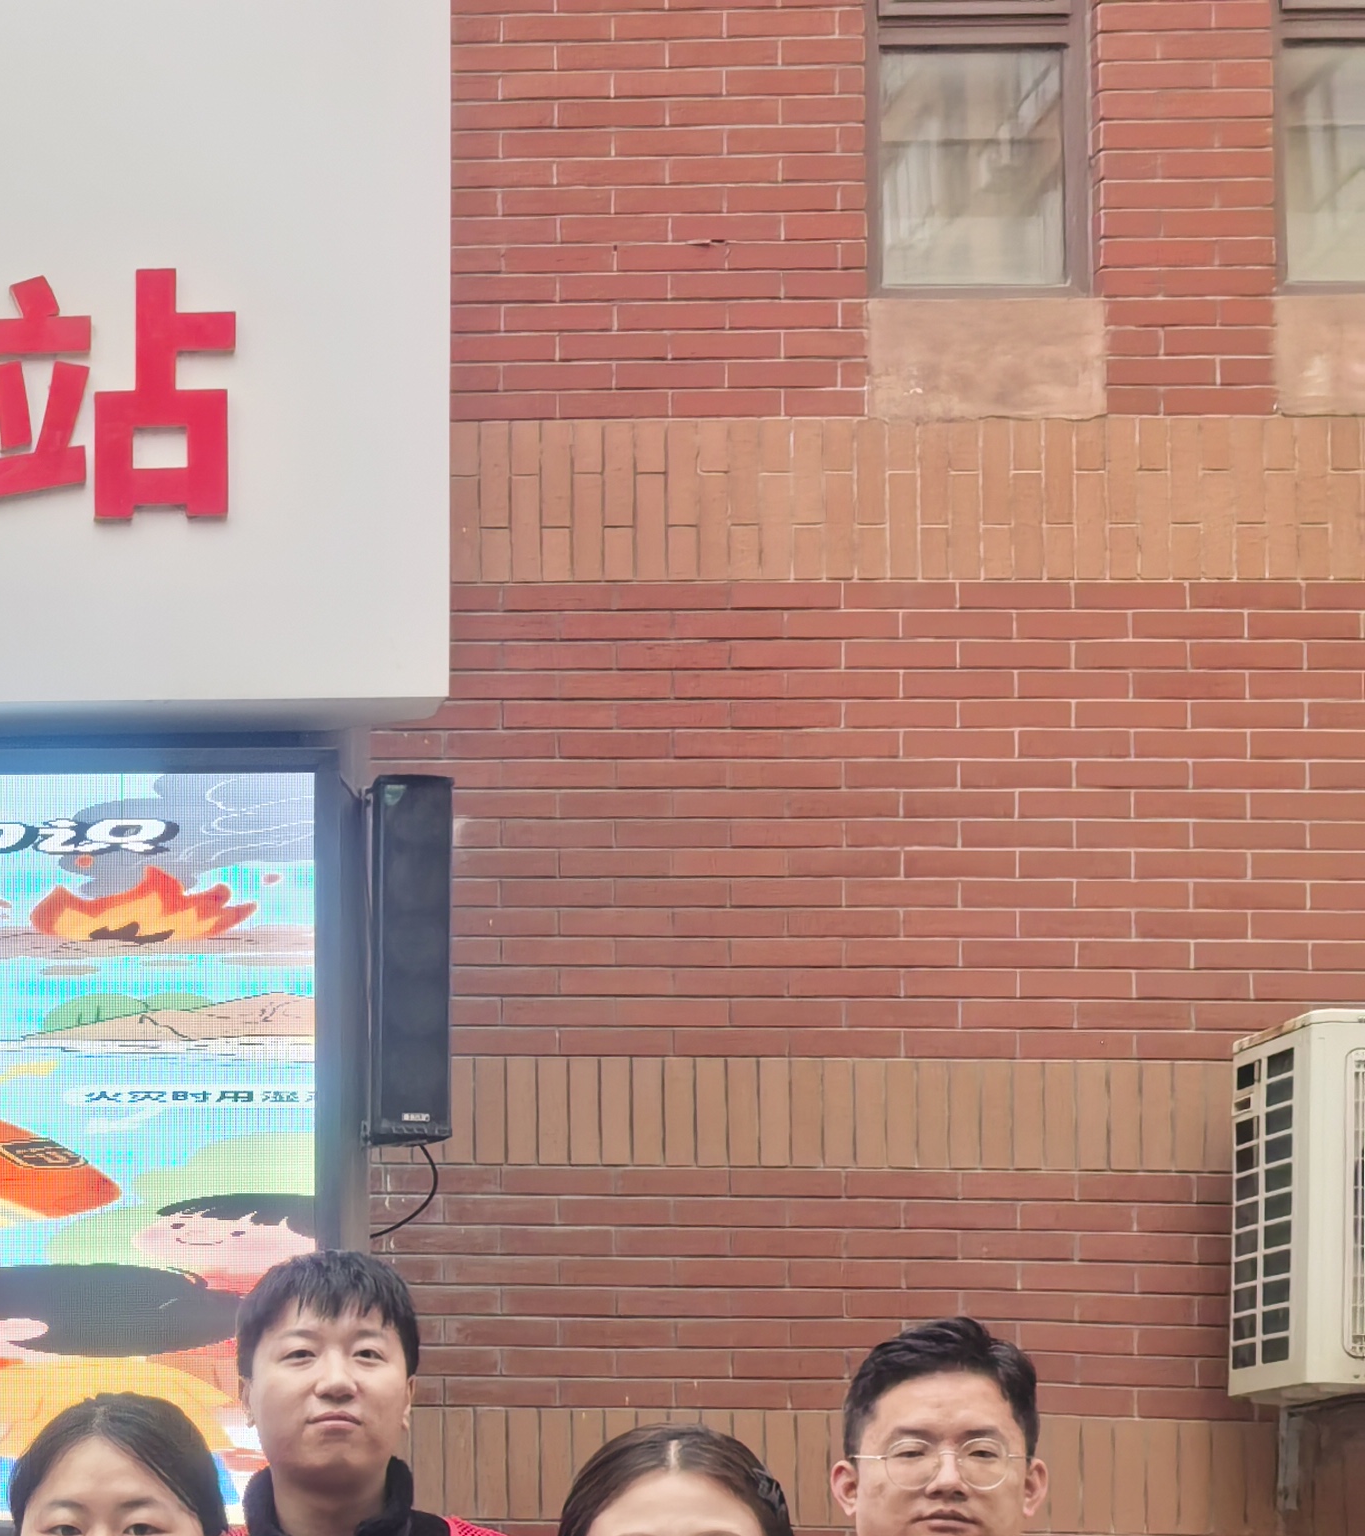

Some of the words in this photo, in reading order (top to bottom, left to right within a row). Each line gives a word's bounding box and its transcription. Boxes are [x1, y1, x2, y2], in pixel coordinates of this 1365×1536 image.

[84, 1090, 315, 1103] 火灾时用湿
